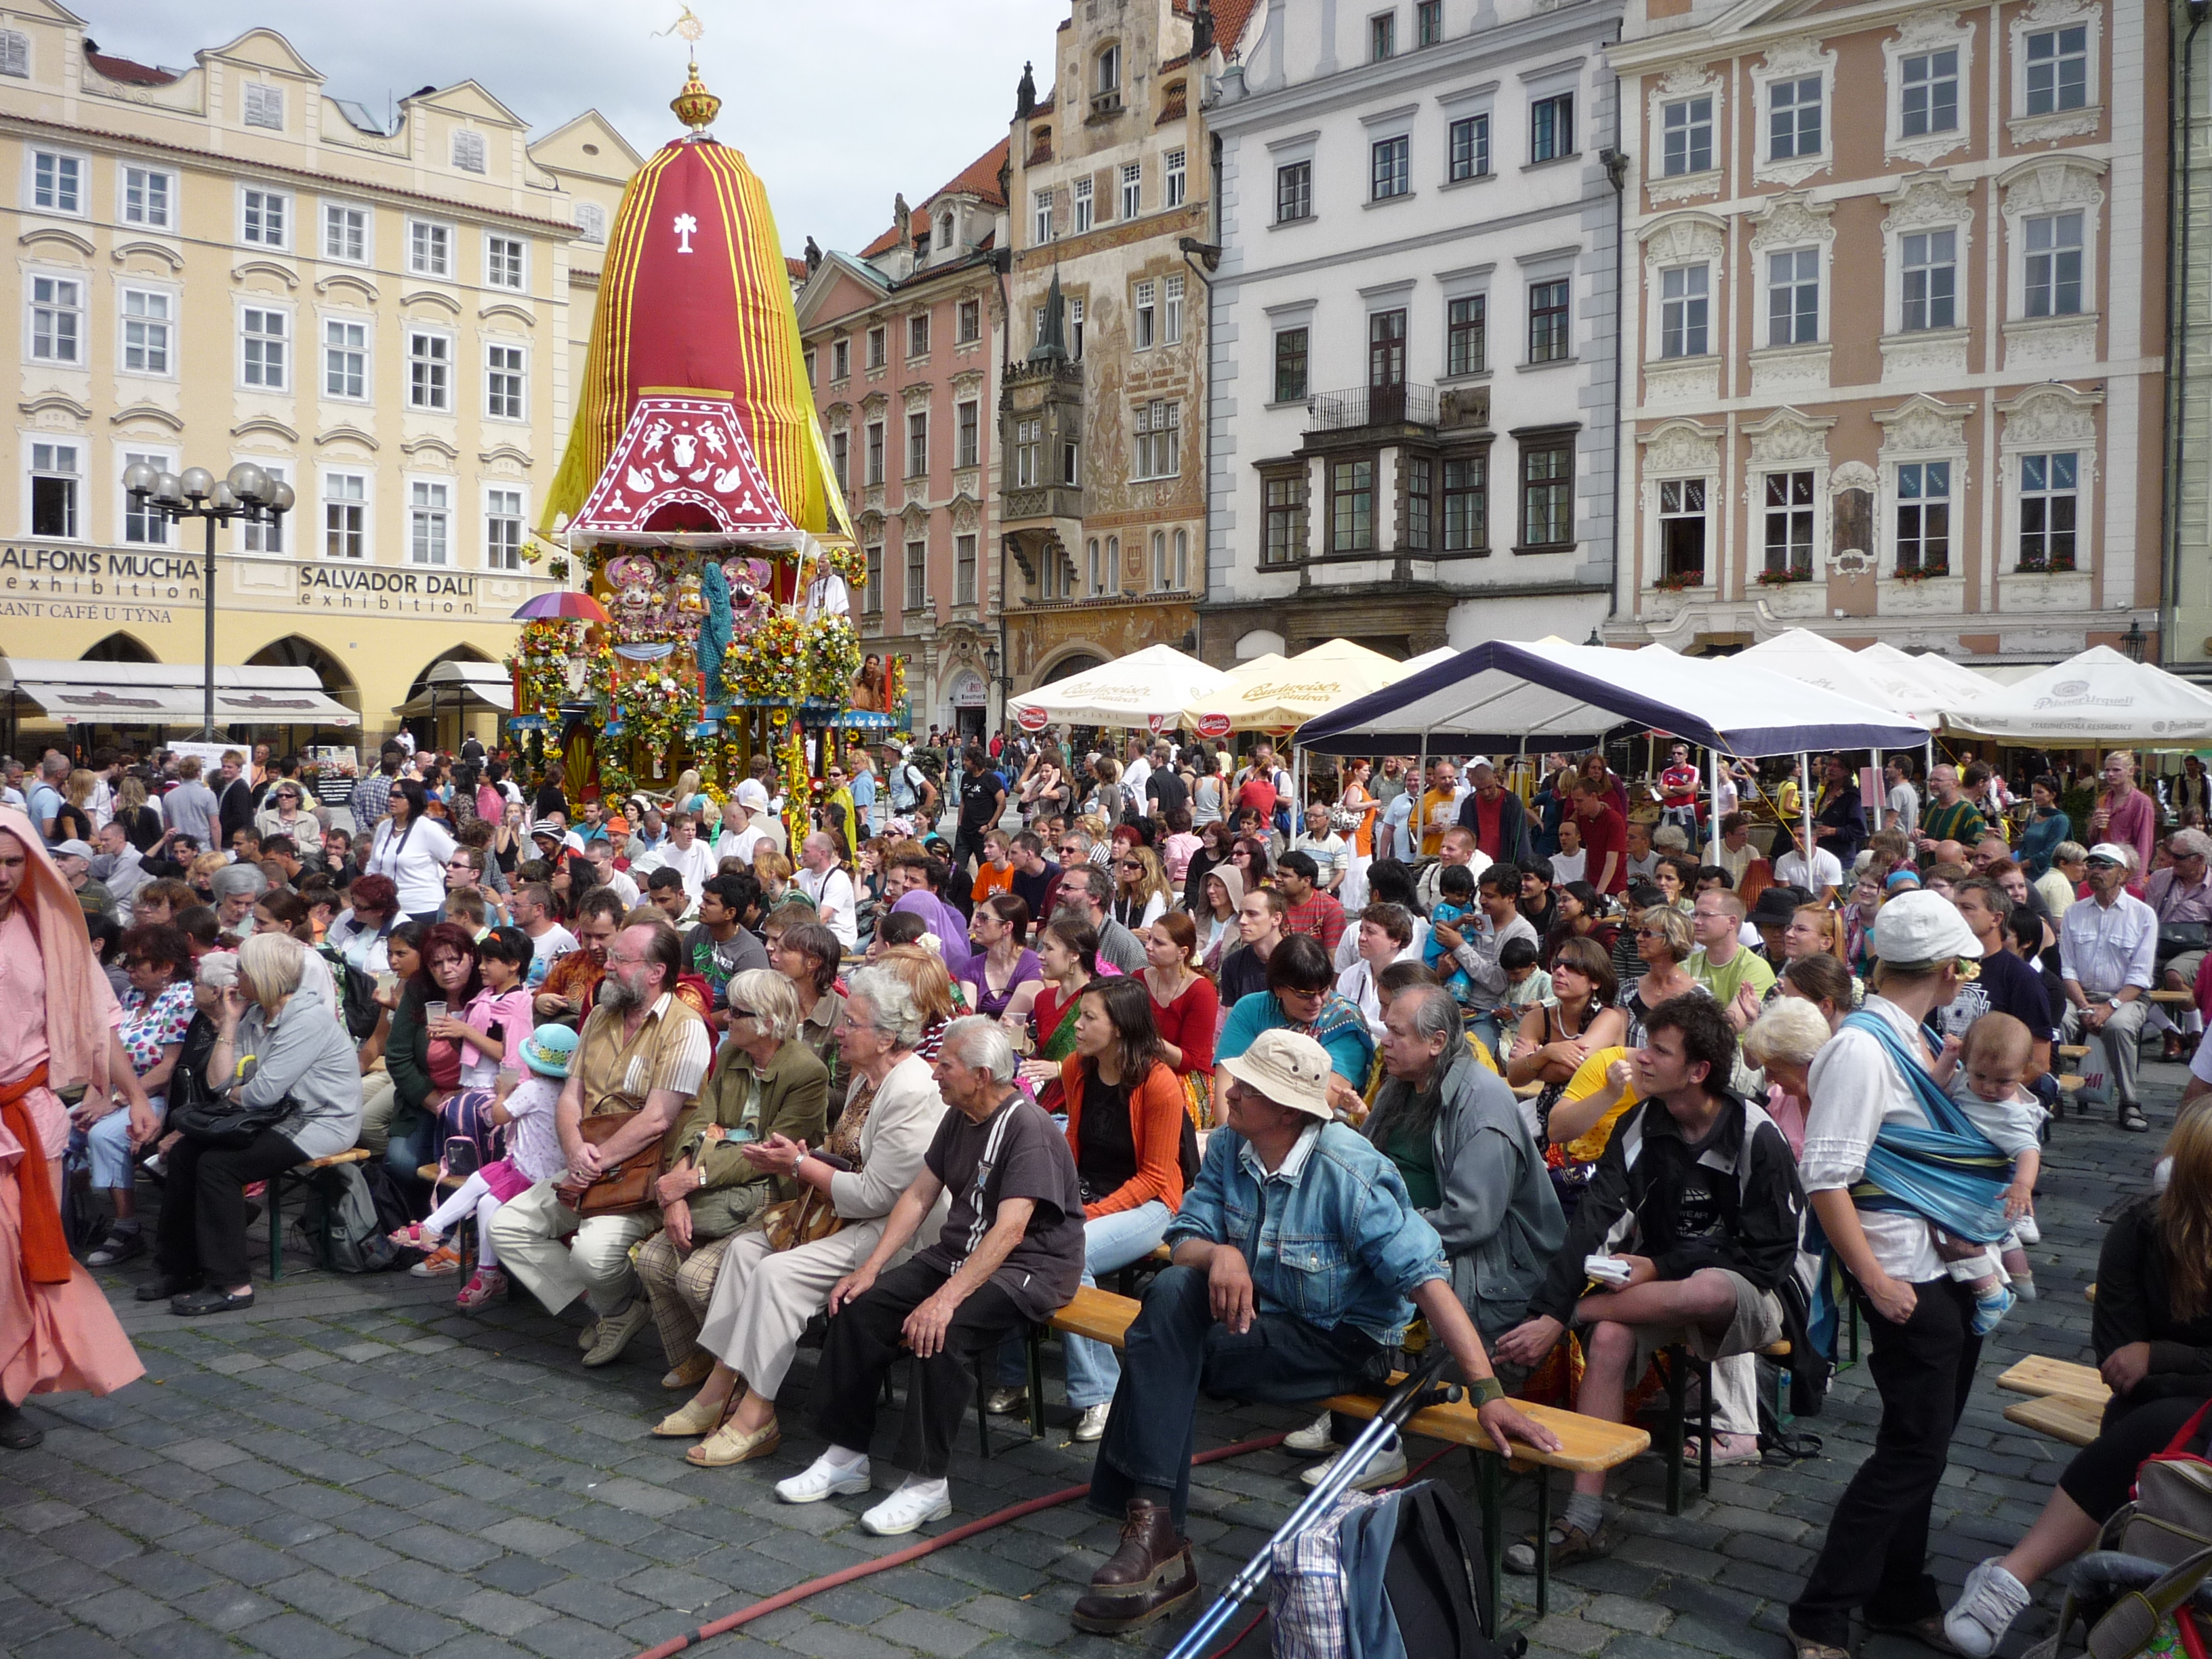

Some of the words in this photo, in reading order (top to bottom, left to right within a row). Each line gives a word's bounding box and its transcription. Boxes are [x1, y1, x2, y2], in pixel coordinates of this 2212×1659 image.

[1, 548, 102, 573] ALFONS
[108, 554, 200, 579] MUCHA
[6, 576, 200, 599] exhibition
[300, 567, 417, 594] SALVADOR
[426, 573, 475, 596] DALÍ
[301, 592, 473, 614] exhibition
[49, 605, 98, 620] CAFÉ
[104, 607, 117, 621] U
[123, 606, 172, 623] TÝNA
[1061, 682, 1151, 699] Budweiser
[1090, 694, 1141, 703] Budvar
[1241, 682, 1342, 702] Budweiser
[1277, 693, 1332, 701] Budvar
[2033, 695, 2085, 710] Pilsner
[2085, 693, 2134, 707] Urquell
[1059, 711, 1120, 720] ORIGINAL
[2087, 722, 2133, 731] RESTAURACE
